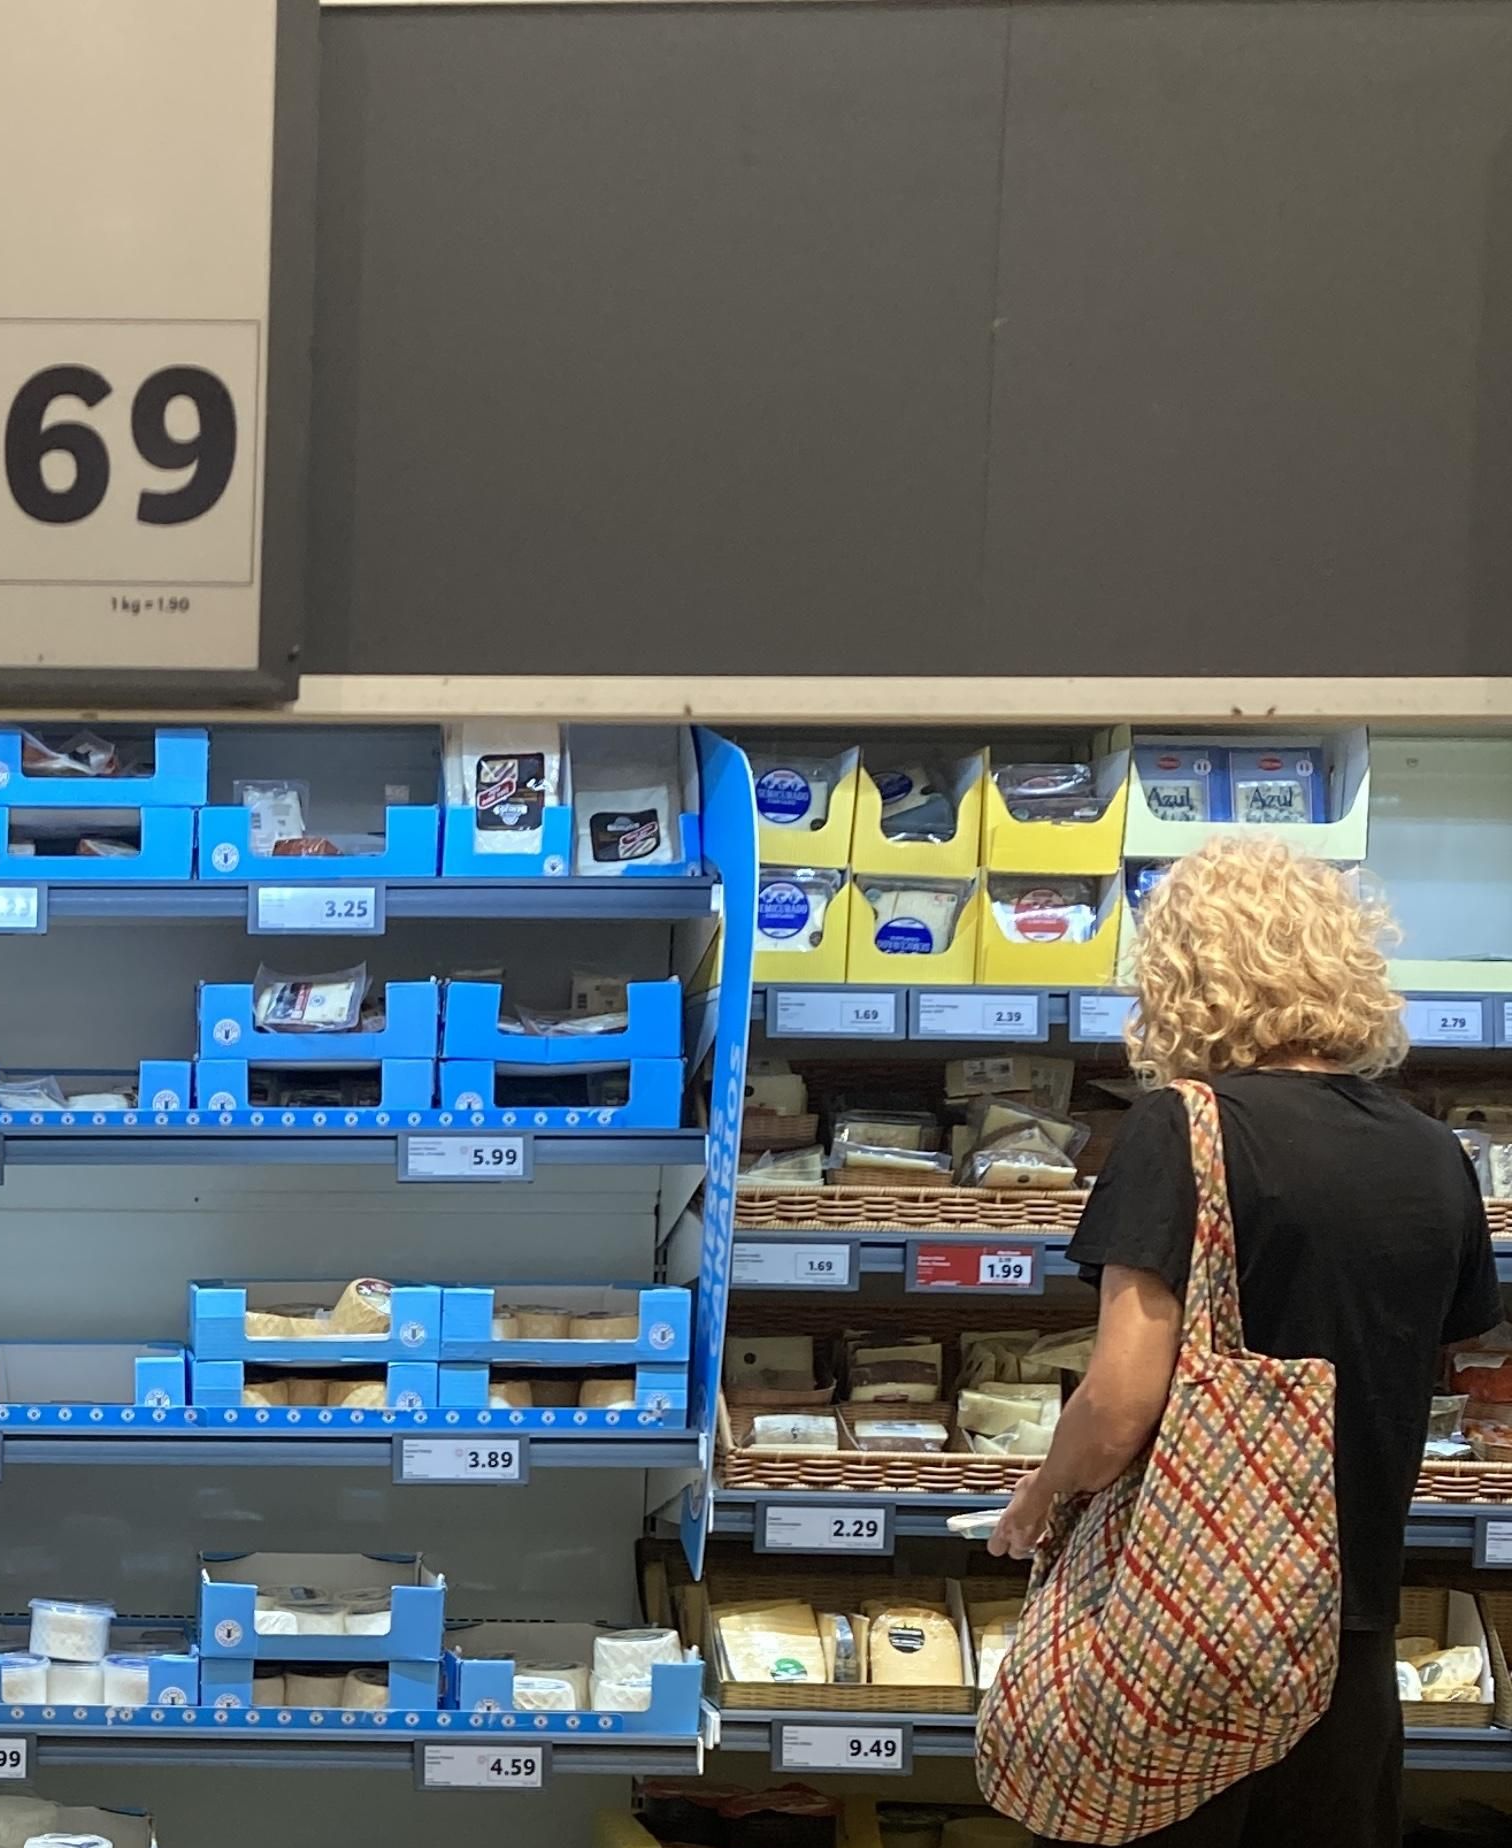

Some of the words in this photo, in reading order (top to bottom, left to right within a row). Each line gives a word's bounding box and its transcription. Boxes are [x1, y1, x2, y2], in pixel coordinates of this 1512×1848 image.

[120, 597, 141, 615] kg
[1147, 786, 1190, 809] Azul
[1249, 787, 1294, 808] Azul
[325, 901, 367, 918] 3.25
[854, 1009, 878, 1020] 1.69
[996, 1011, 1021, 1022] 2.39
[1441, 1018, 1466, 1028] 2.79
[473, 1149, 517, 1165] 5.99
[808, 1260, 832, 1271] 1.69
[987, 1264, 1023, 1278] 1.99
[468, 1451, 513, 1468] 3.89
[832, 1520, 878, 1537] 2.29
[850, 1740, 896, 1757] 9.49
[491, 1758, 535, 1776] 4.59
